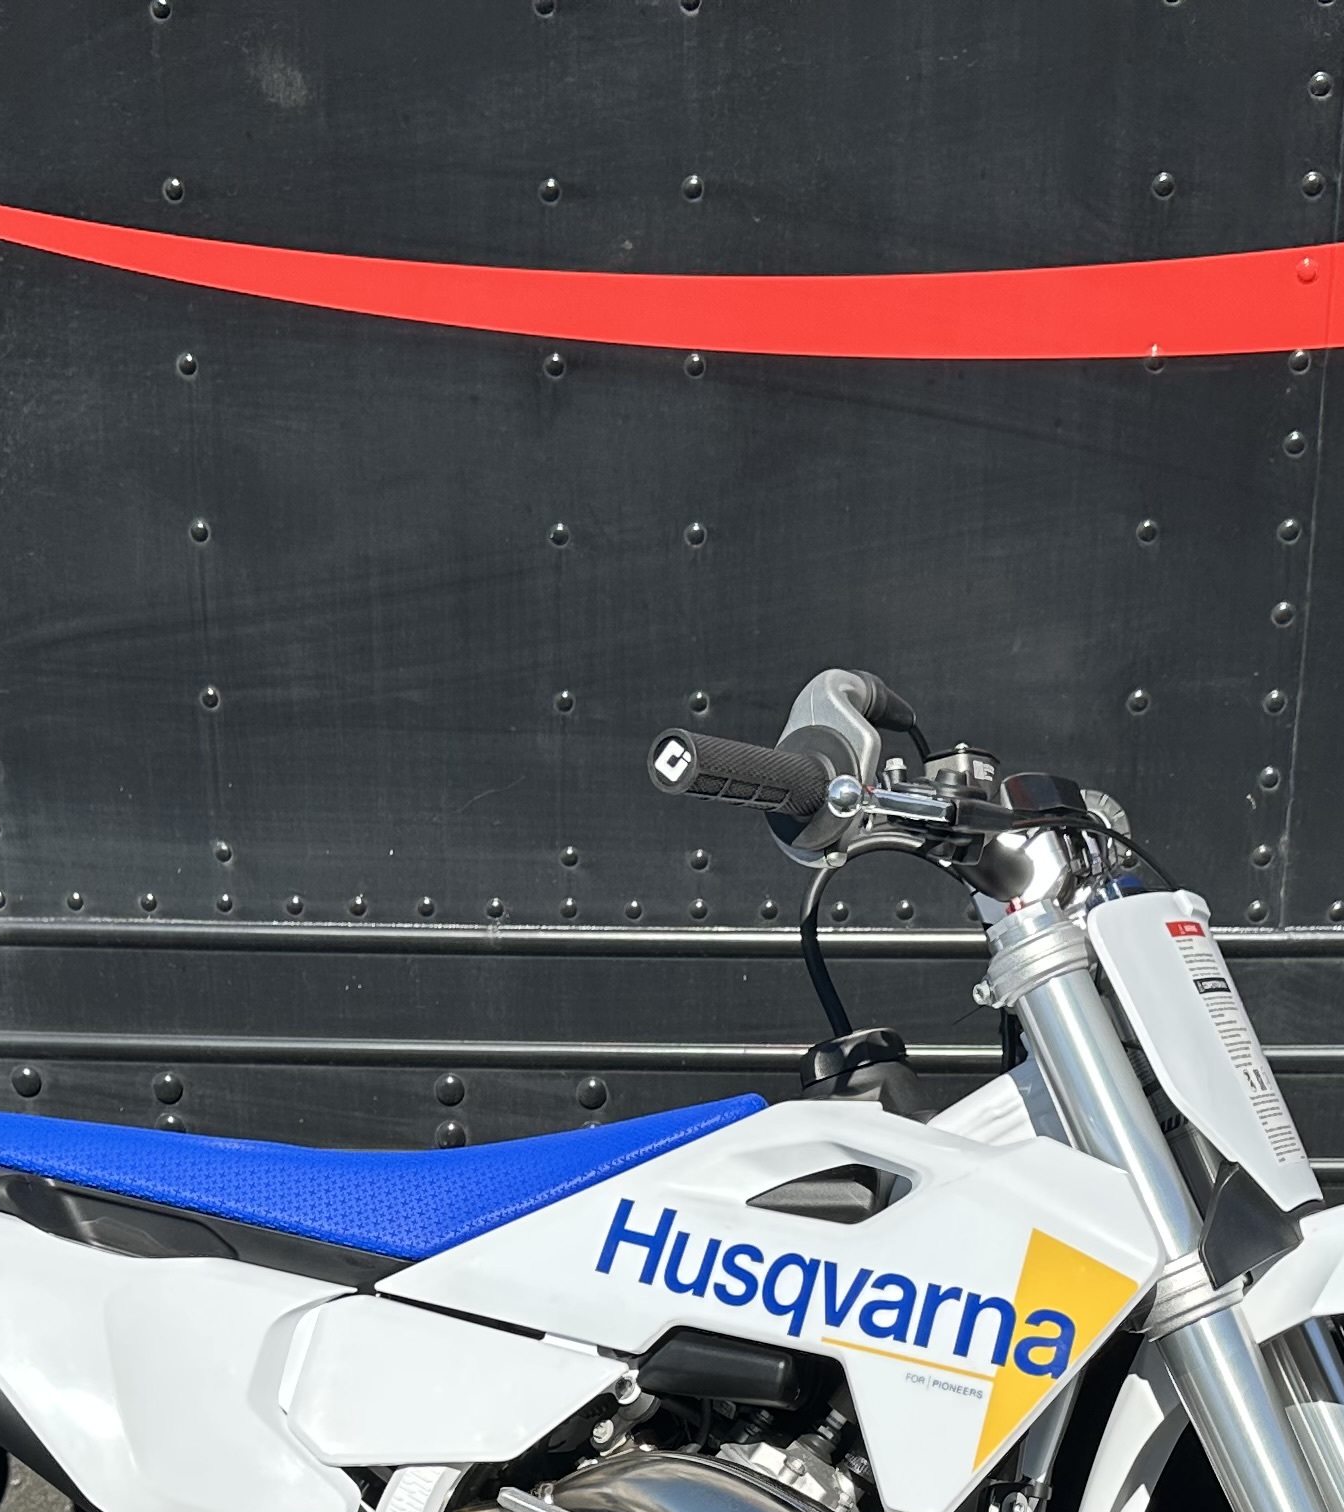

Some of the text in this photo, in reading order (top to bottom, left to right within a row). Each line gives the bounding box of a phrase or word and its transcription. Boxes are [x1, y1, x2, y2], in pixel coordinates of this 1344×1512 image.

[594, 1197, 1077, 1380] Husqvarna
[905, 1372, 984, 1400] FOR PIONEERS
